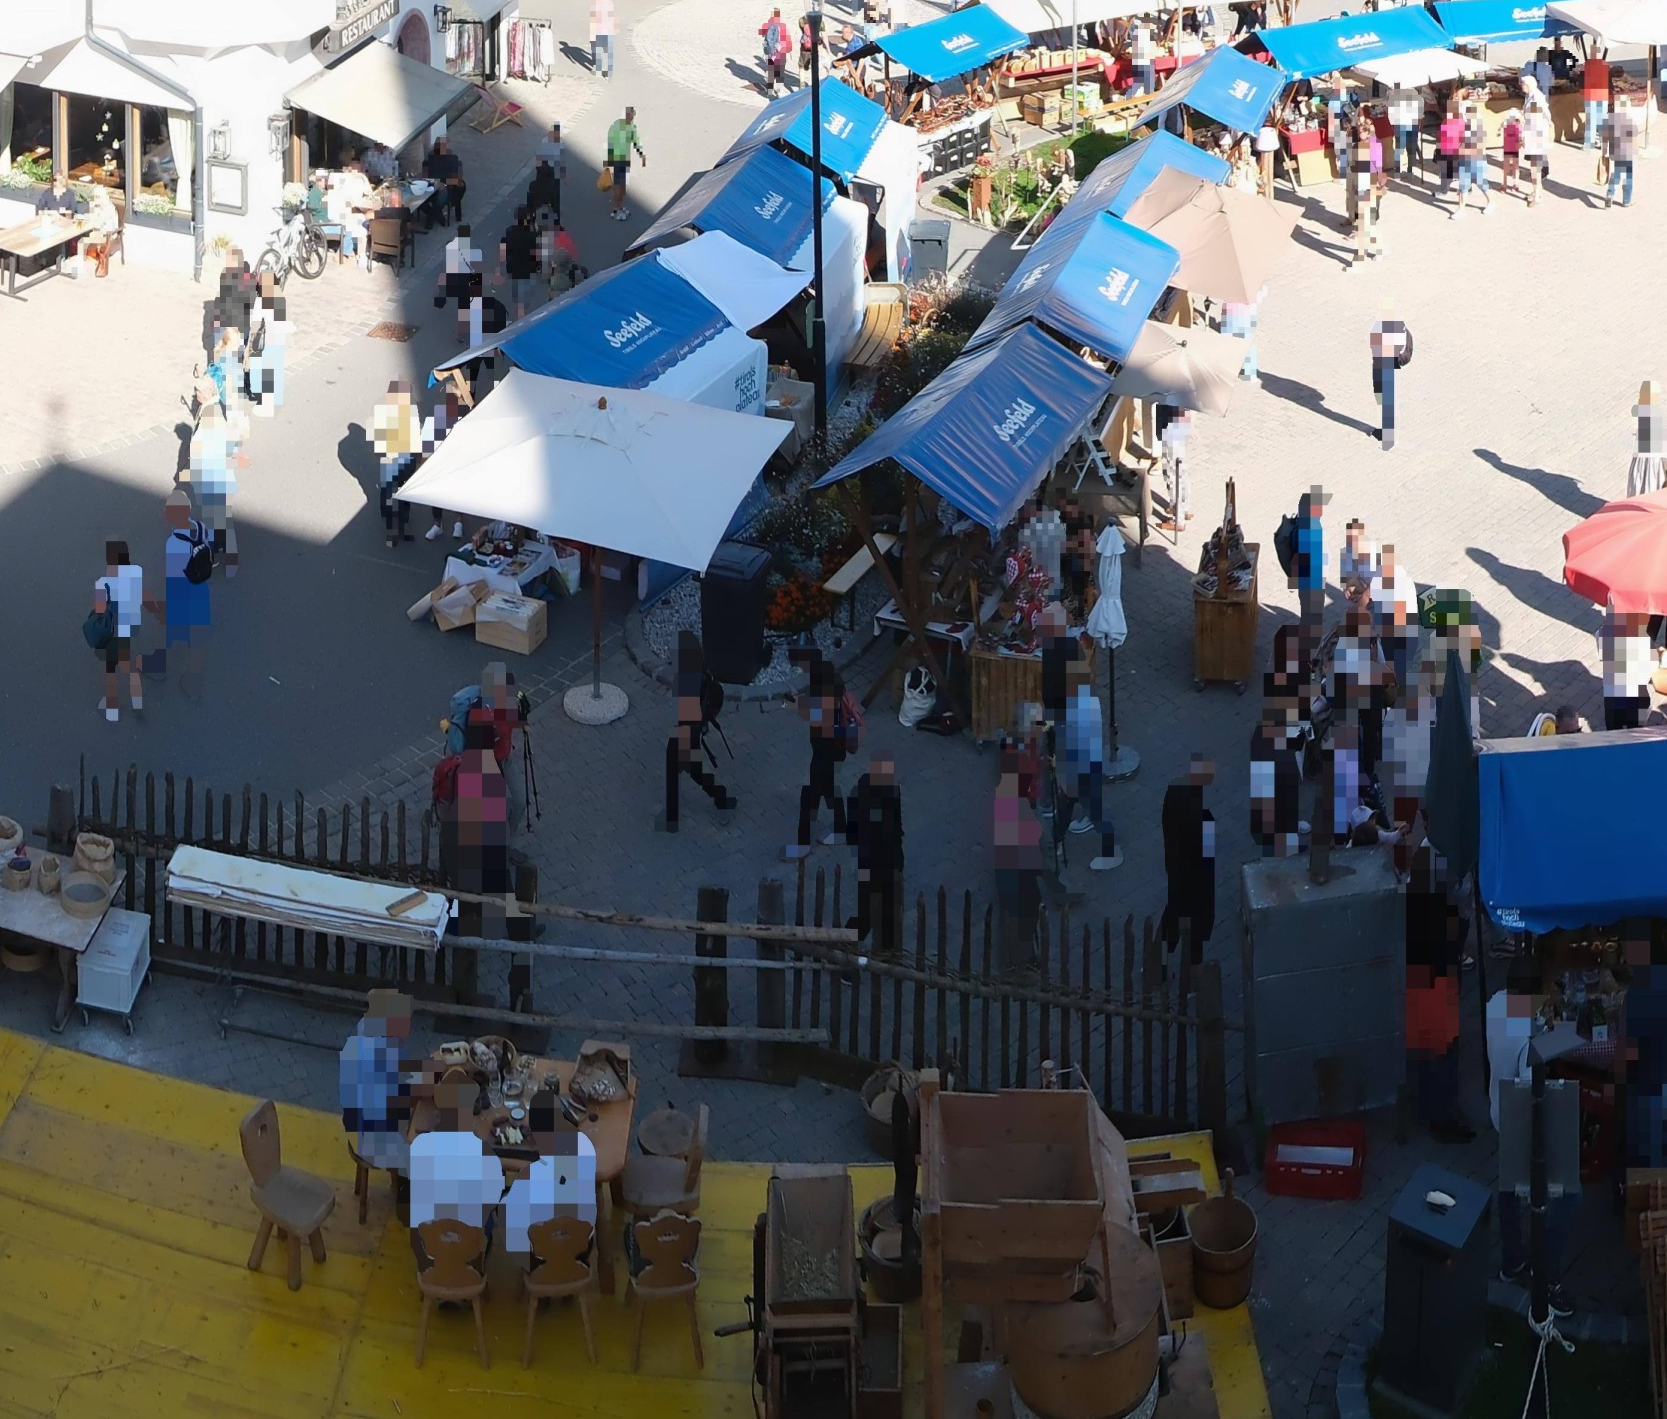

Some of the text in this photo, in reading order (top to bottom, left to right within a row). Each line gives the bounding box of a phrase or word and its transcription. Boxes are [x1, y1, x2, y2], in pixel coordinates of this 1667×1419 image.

[754, 190, 784, 219] Seefeld
[603, 311, 653, 348] Seefeld
[734, 366, 756, 390] #tirols
[992, 398, 1036, 441] Seefeld
